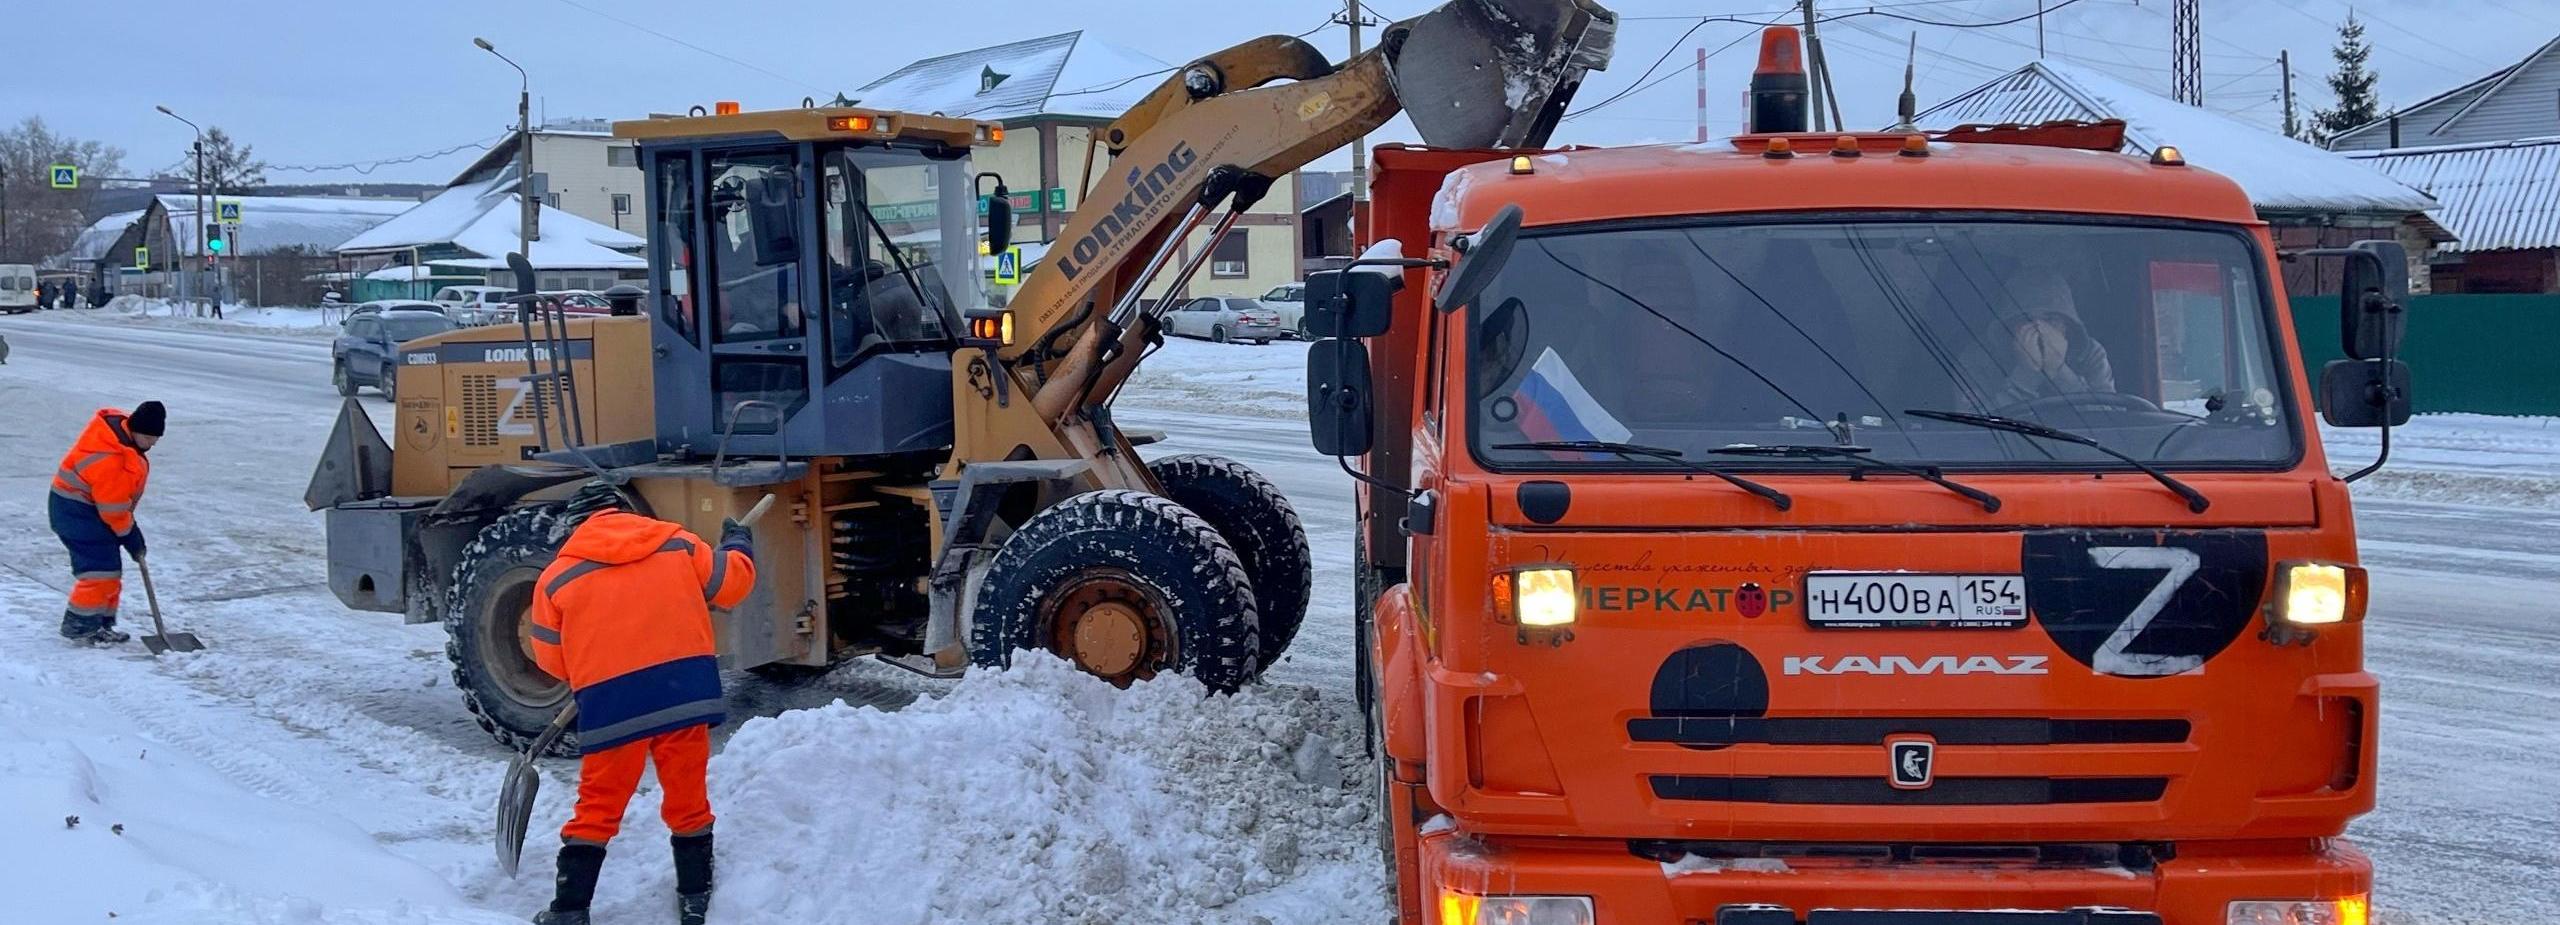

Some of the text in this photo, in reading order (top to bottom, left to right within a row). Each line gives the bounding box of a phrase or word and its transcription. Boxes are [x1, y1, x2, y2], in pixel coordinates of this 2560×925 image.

[484, 342, 558, 363] LONKN
[1964, 580, 2016, 604] 154
[1976, 605, 2001, 616] RUS
[2087, 545, 2205, 677] Z
[1783, 655, 2049, 676] KAMAZ
